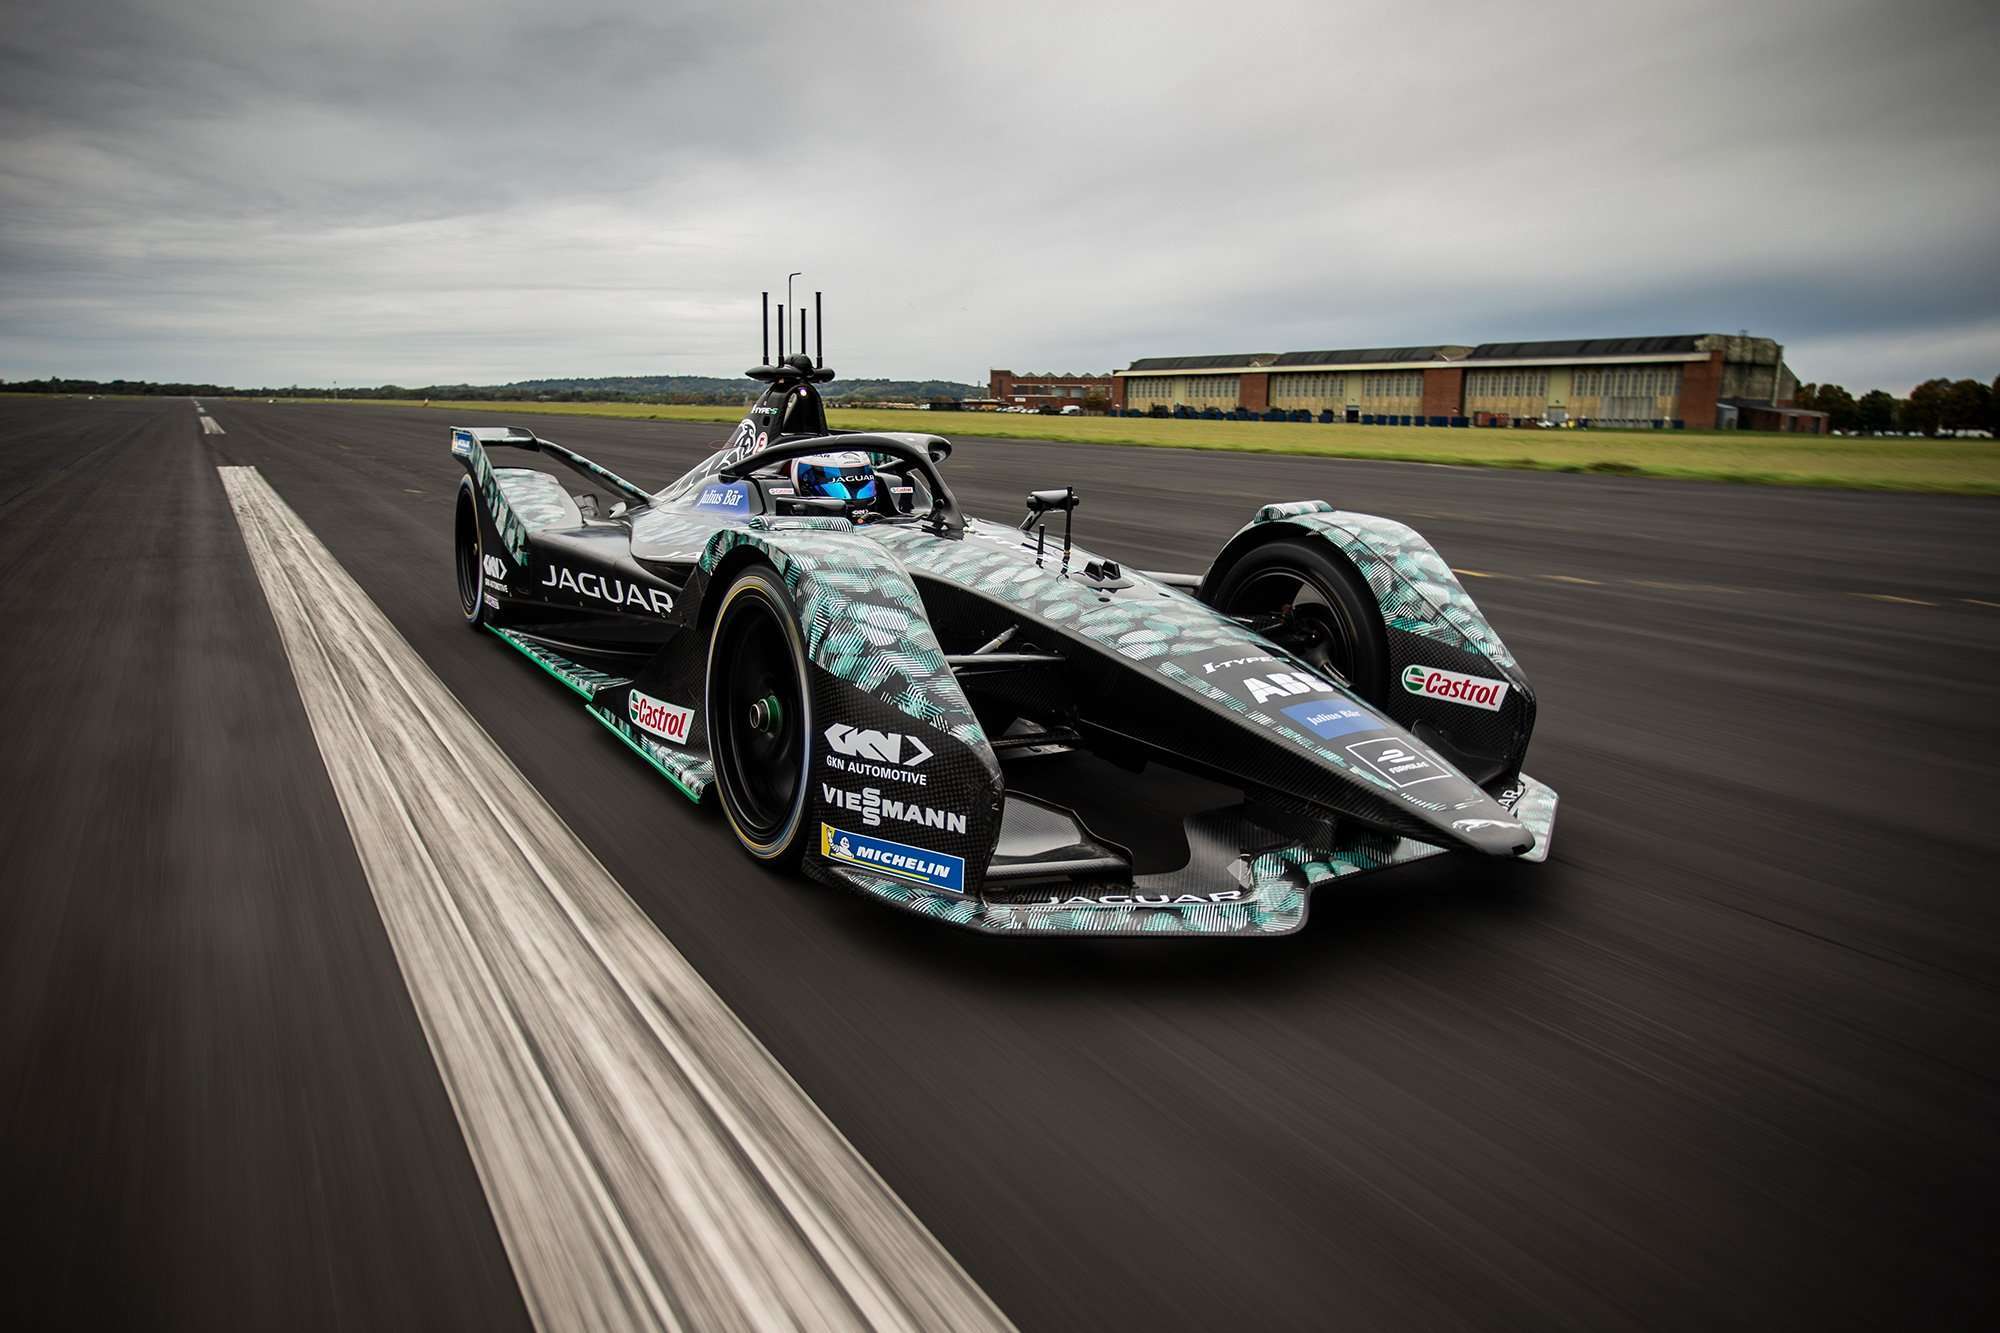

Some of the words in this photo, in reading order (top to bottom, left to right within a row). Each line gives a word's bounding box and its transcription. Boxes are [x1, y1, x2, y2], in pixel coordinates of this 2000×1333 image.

[831, 474, 875, 484] JAGUAR
[542, 565, 674, 613] JAGUAR
[1425, 671, 1500, 707] Castrol
[638, 698, 687, 738] Castrol
[826, 755, 845, 771] GKN
[847, 761, 928, 786] AUTOMOTIVE
[856, 846, 951, 878] MICHELIN
